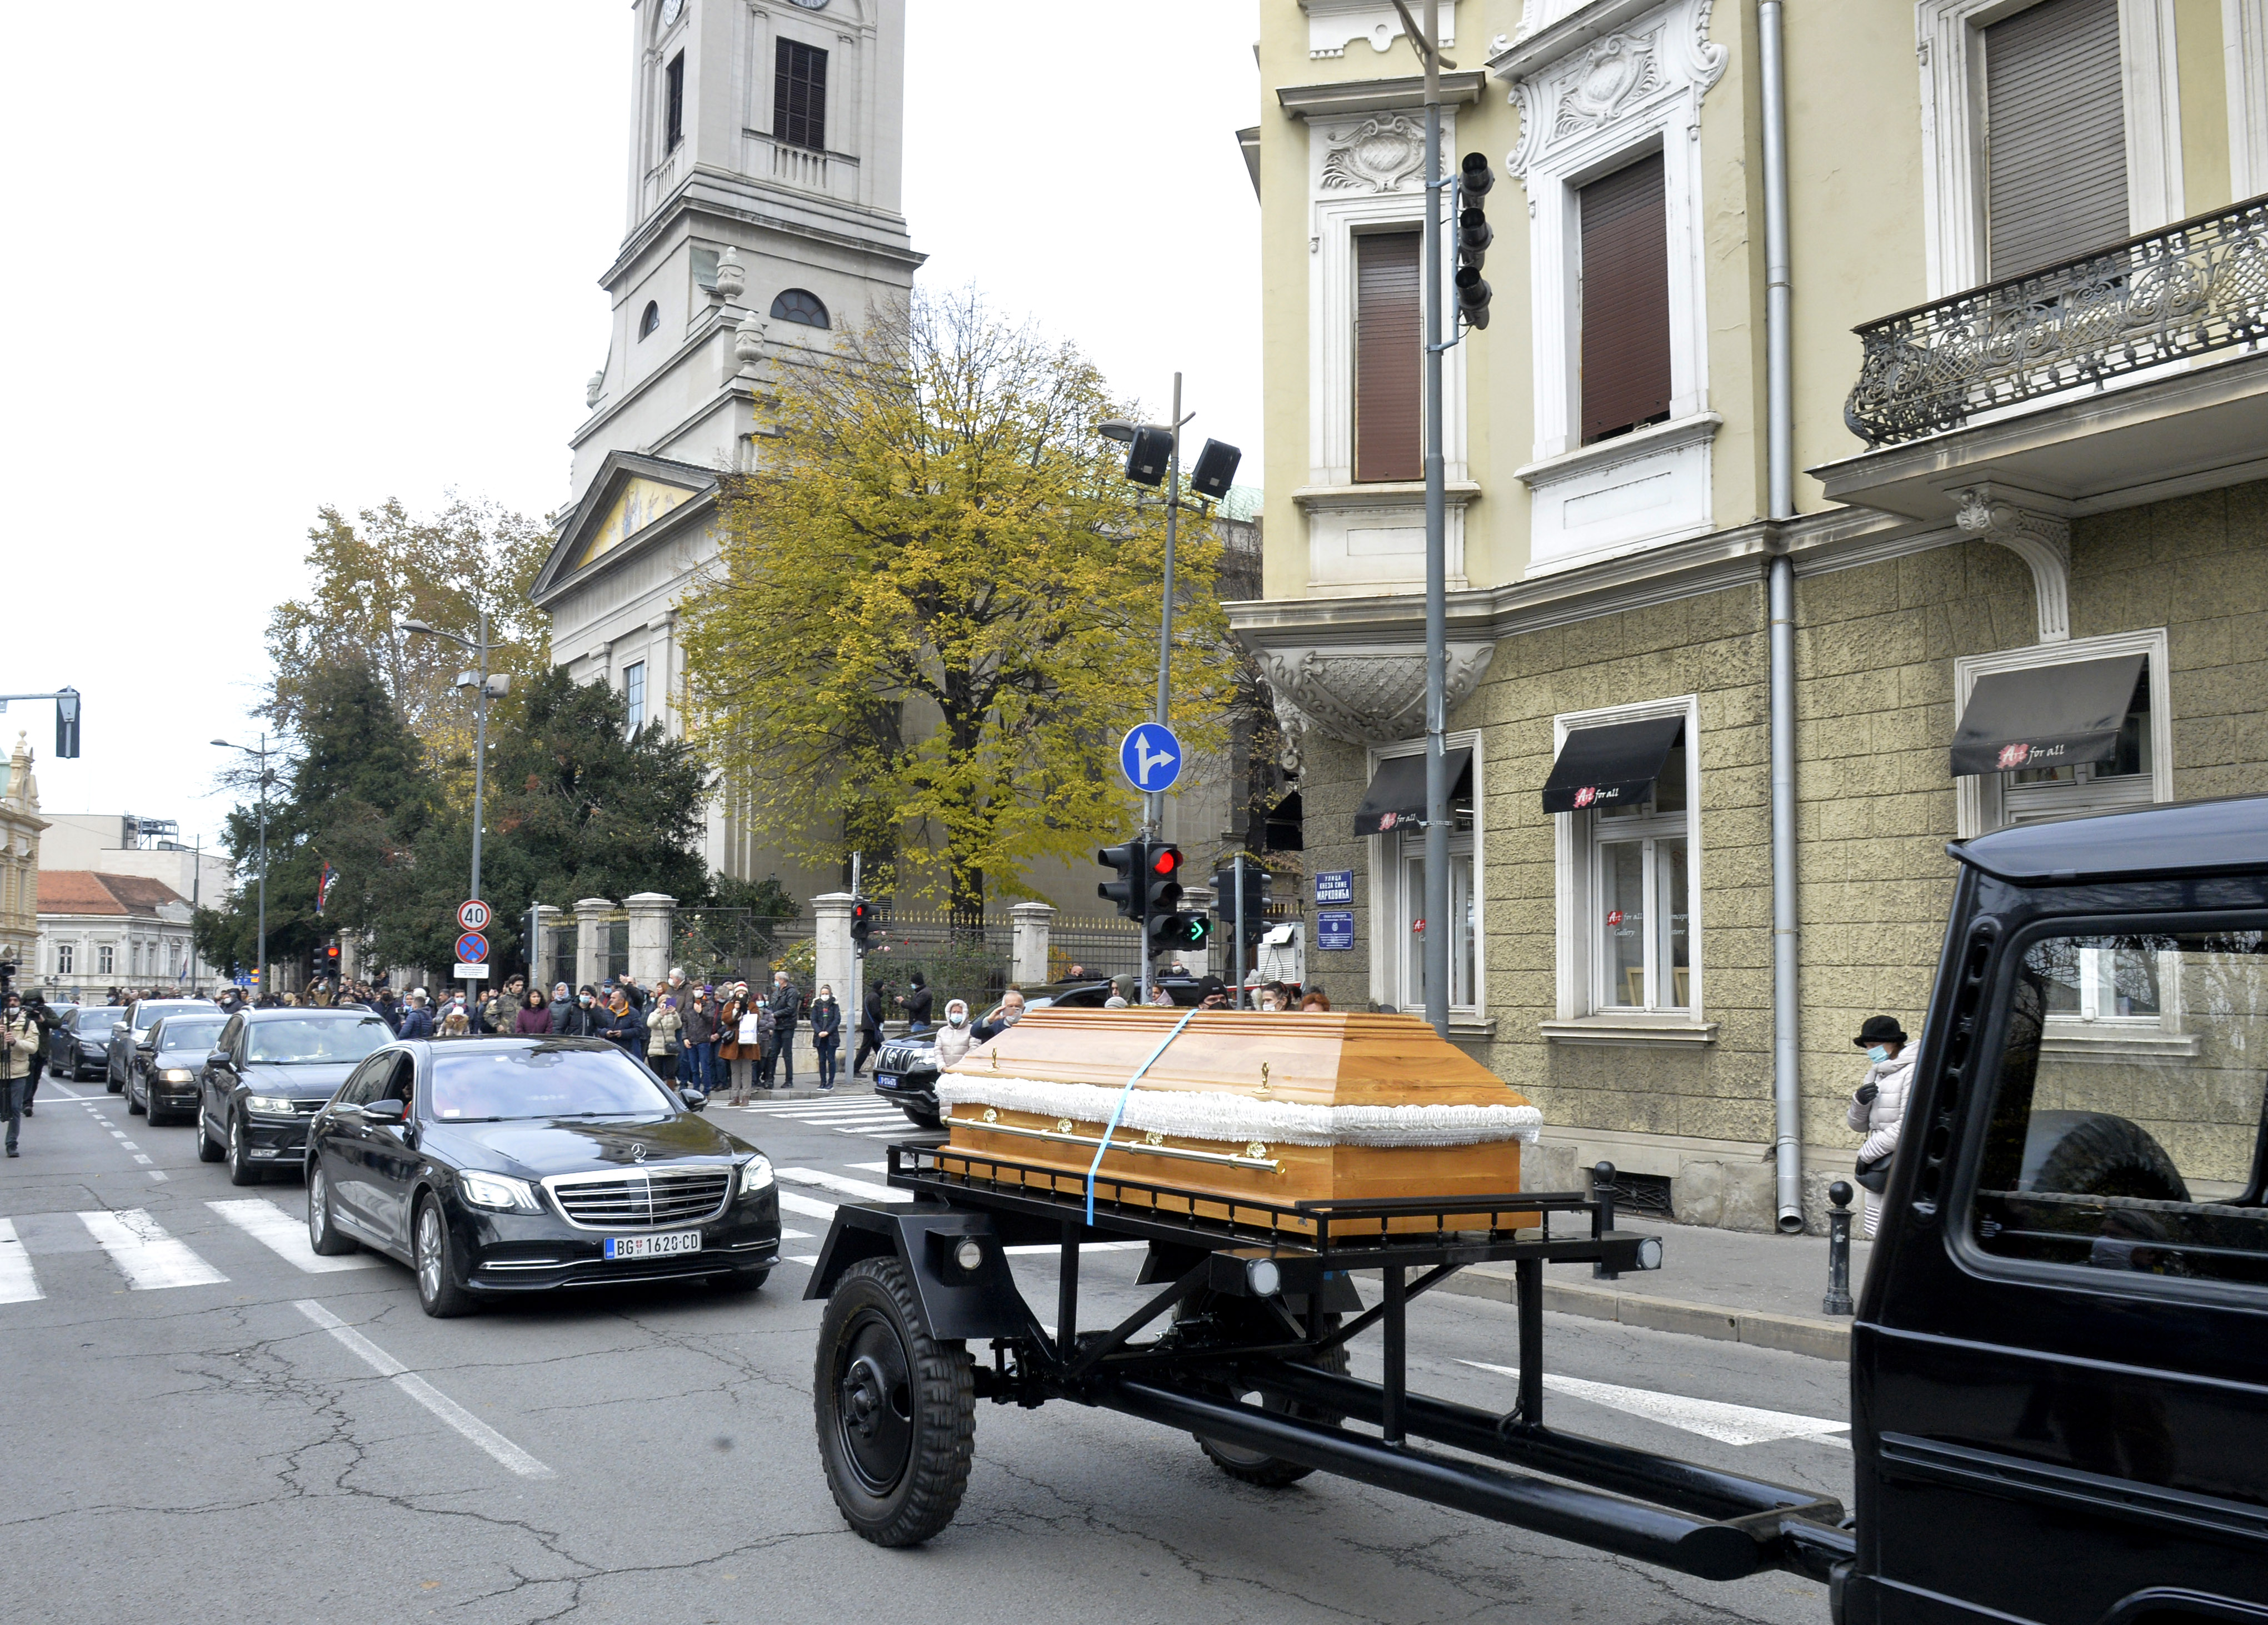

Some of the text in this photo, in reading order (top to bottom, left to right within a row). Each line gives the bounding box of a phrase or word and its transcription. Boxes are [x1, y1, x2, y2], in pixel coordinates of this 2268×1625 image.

[2002, 744, 2065, 764] Art for all
[1577, 788, 1619, 804] Art for all
[1382, 813, 1416, 828] Art for all
[1317, 889, 1350, 901] МАРКОВИЋА
[464, 908, 483, 923] 40
[1609, 912, 1621, 922] Art
[1622, 913, 1632, 924] for
[1614, 928, 1635, 937] Gallery
[617, 1239, 633, 1256] BG
